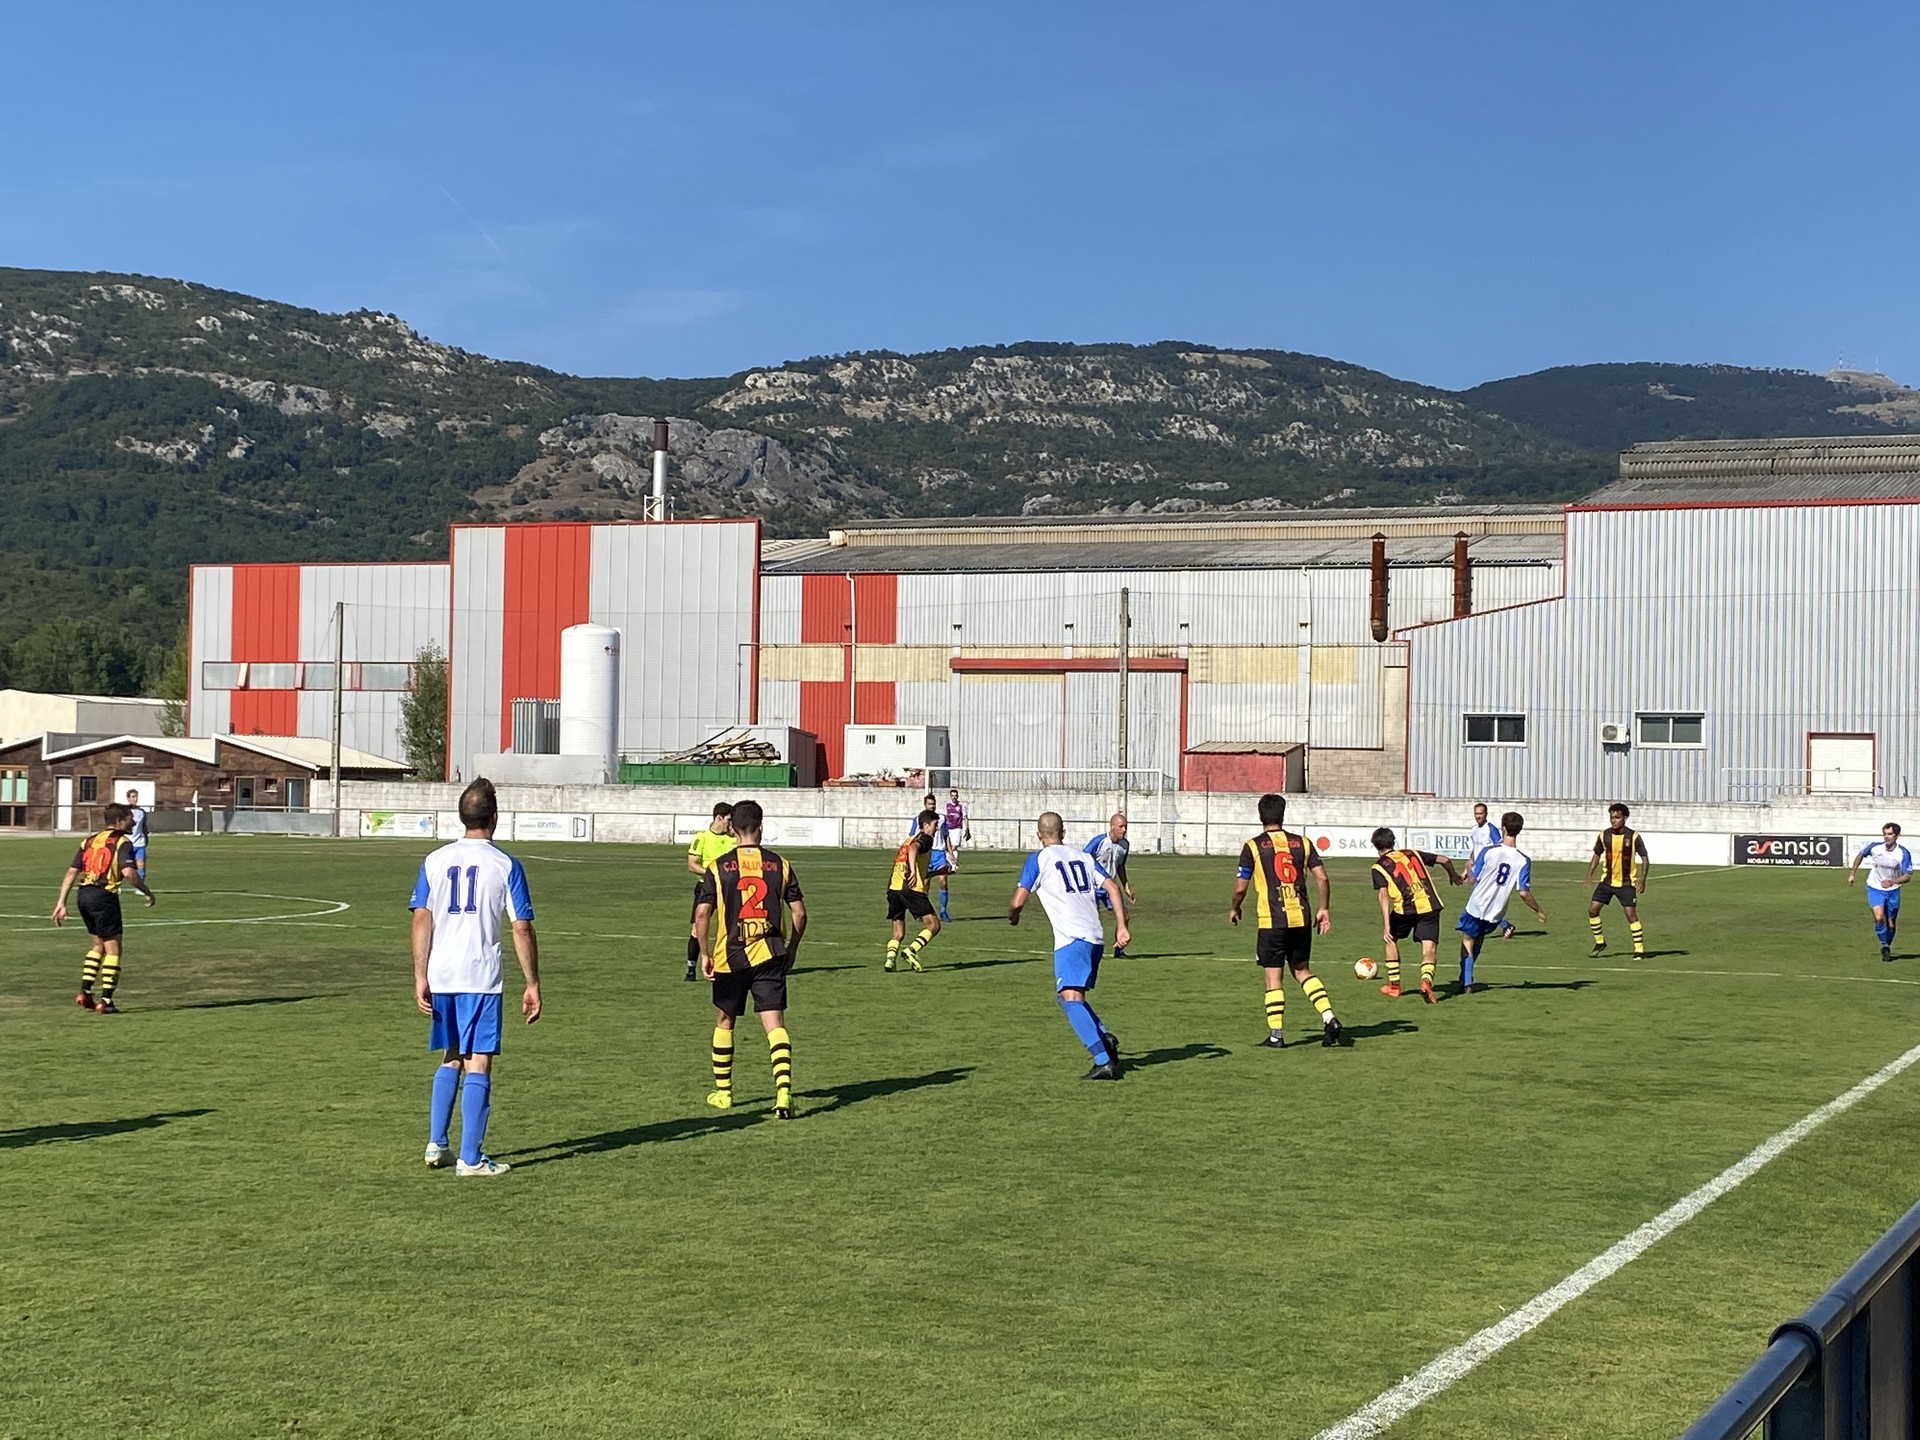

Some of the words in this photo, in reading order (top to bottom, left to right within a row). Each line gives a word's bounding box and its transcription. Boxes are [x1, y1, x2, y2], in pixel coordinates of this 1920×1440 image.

[1338, 838, 1400, 849] SAKA
[1055, 860, 1091, 893] 10
[1274, 851, 1297, 883] 6
[1394, 856, 1427, 886] 11
[1496, 863, 1511, 886] 8
[447, 866, 479, 914] 11
[736, 876, 768, 919] 2
